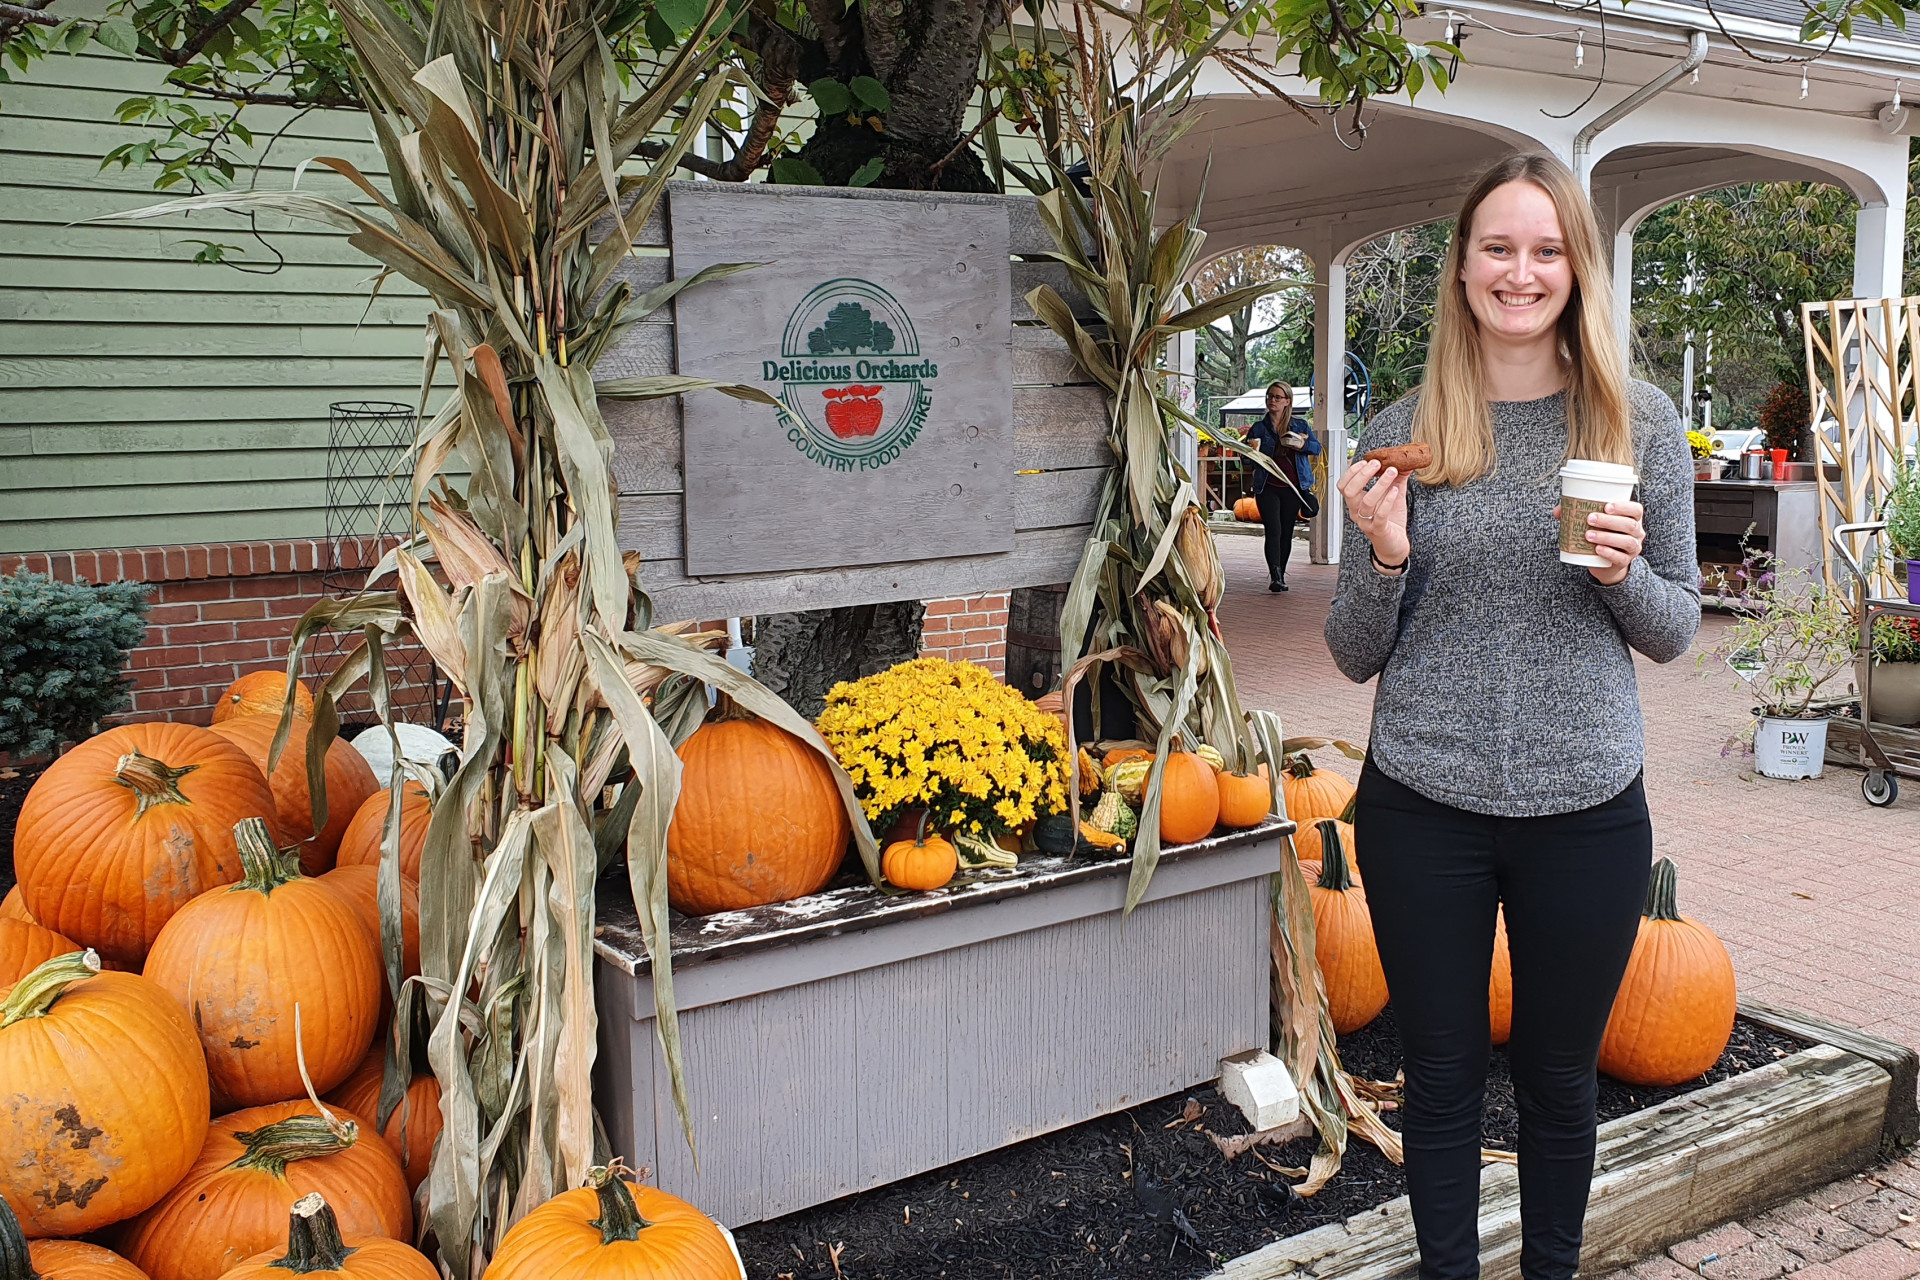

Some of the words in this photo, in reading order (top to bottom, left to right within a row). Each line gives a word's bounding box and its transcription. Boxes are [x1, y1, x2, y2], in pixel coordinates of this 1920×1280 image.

[763, 360, 851, 381] Delicious
[856, 358, 938, 379] Orchards
[787, 428, 855, 472] COUNTRY
[859, 444, 900, 472] FOOD
[899, 384, 933, 449] MARKET
